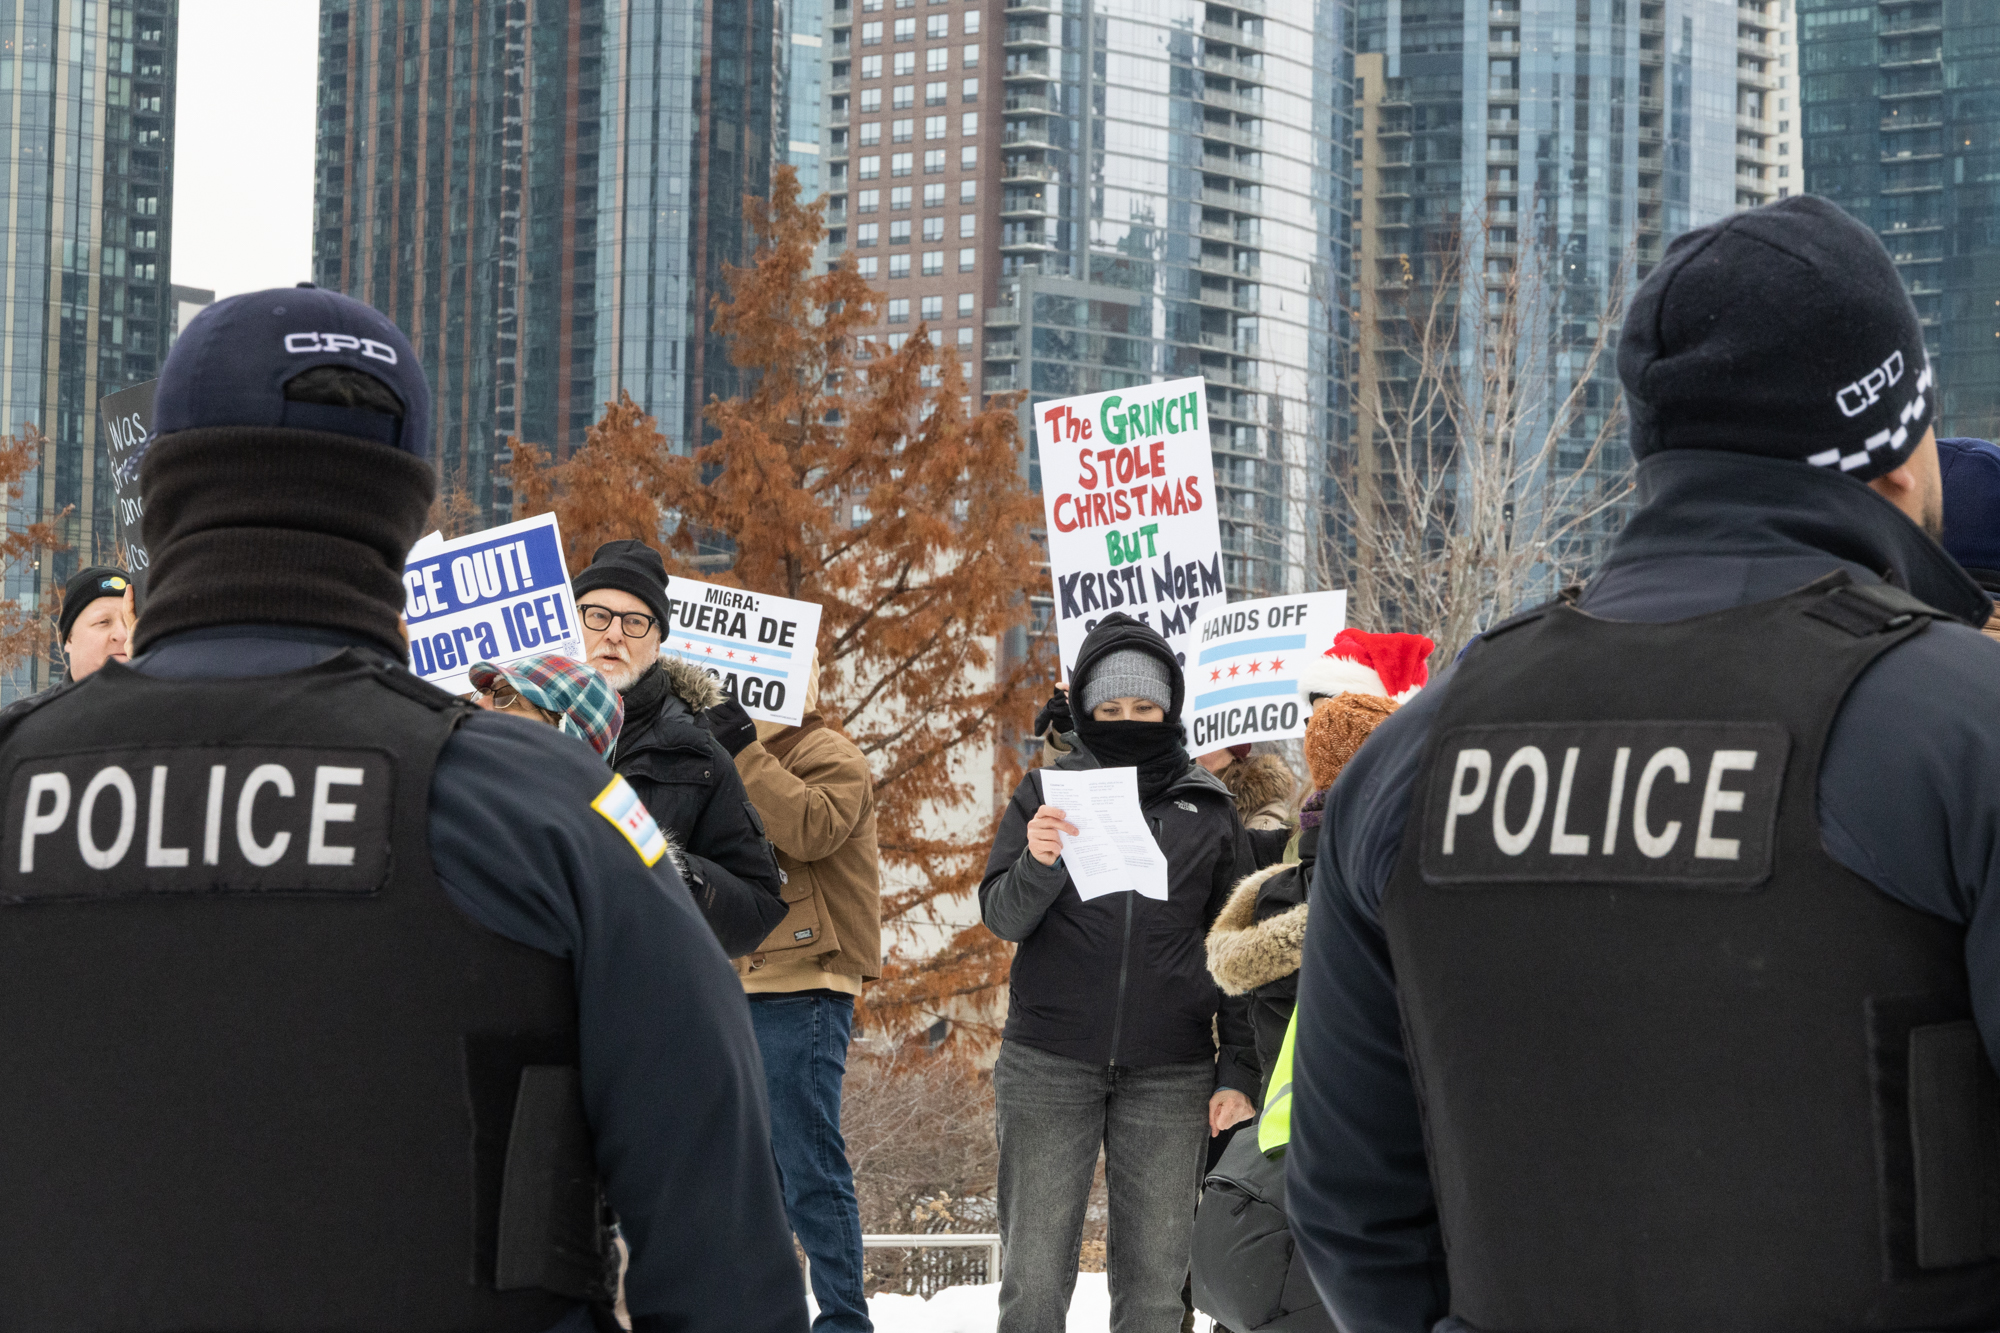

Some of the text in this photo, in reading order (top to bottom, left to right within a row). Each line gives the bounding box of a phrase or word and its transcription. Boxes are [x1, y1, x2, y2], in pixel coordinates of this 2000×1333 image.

[284, 332, 398, 365] CPD
[1836, 350, 1904, 417] CPD
[1044, 391, 1198, 445] The GRINCH
[1078, 441, 1166, 490] STOLE
[1053, 476, 1203, 533] CHRISTMAS
[1105, 523, 1159, 566] BUT
[402, 540, 534, 621] CE OUT!
[704, 587, 760, 612] MIGRA:
[1058, 551, 1223, 620] KRISTI NOEM
[501, 592, 571, 653] ICE!
[669, 598, 797, 648] FUERA DE
[1160, 601, 1199, 638] MY
[1201, 604, 1308, 643] HANDS OFF
[1193, 702, 1299, 747] CHICAGO
[19, 763, 364, 873] POLICE
[1442, 745, 1758, 860] POLICE
